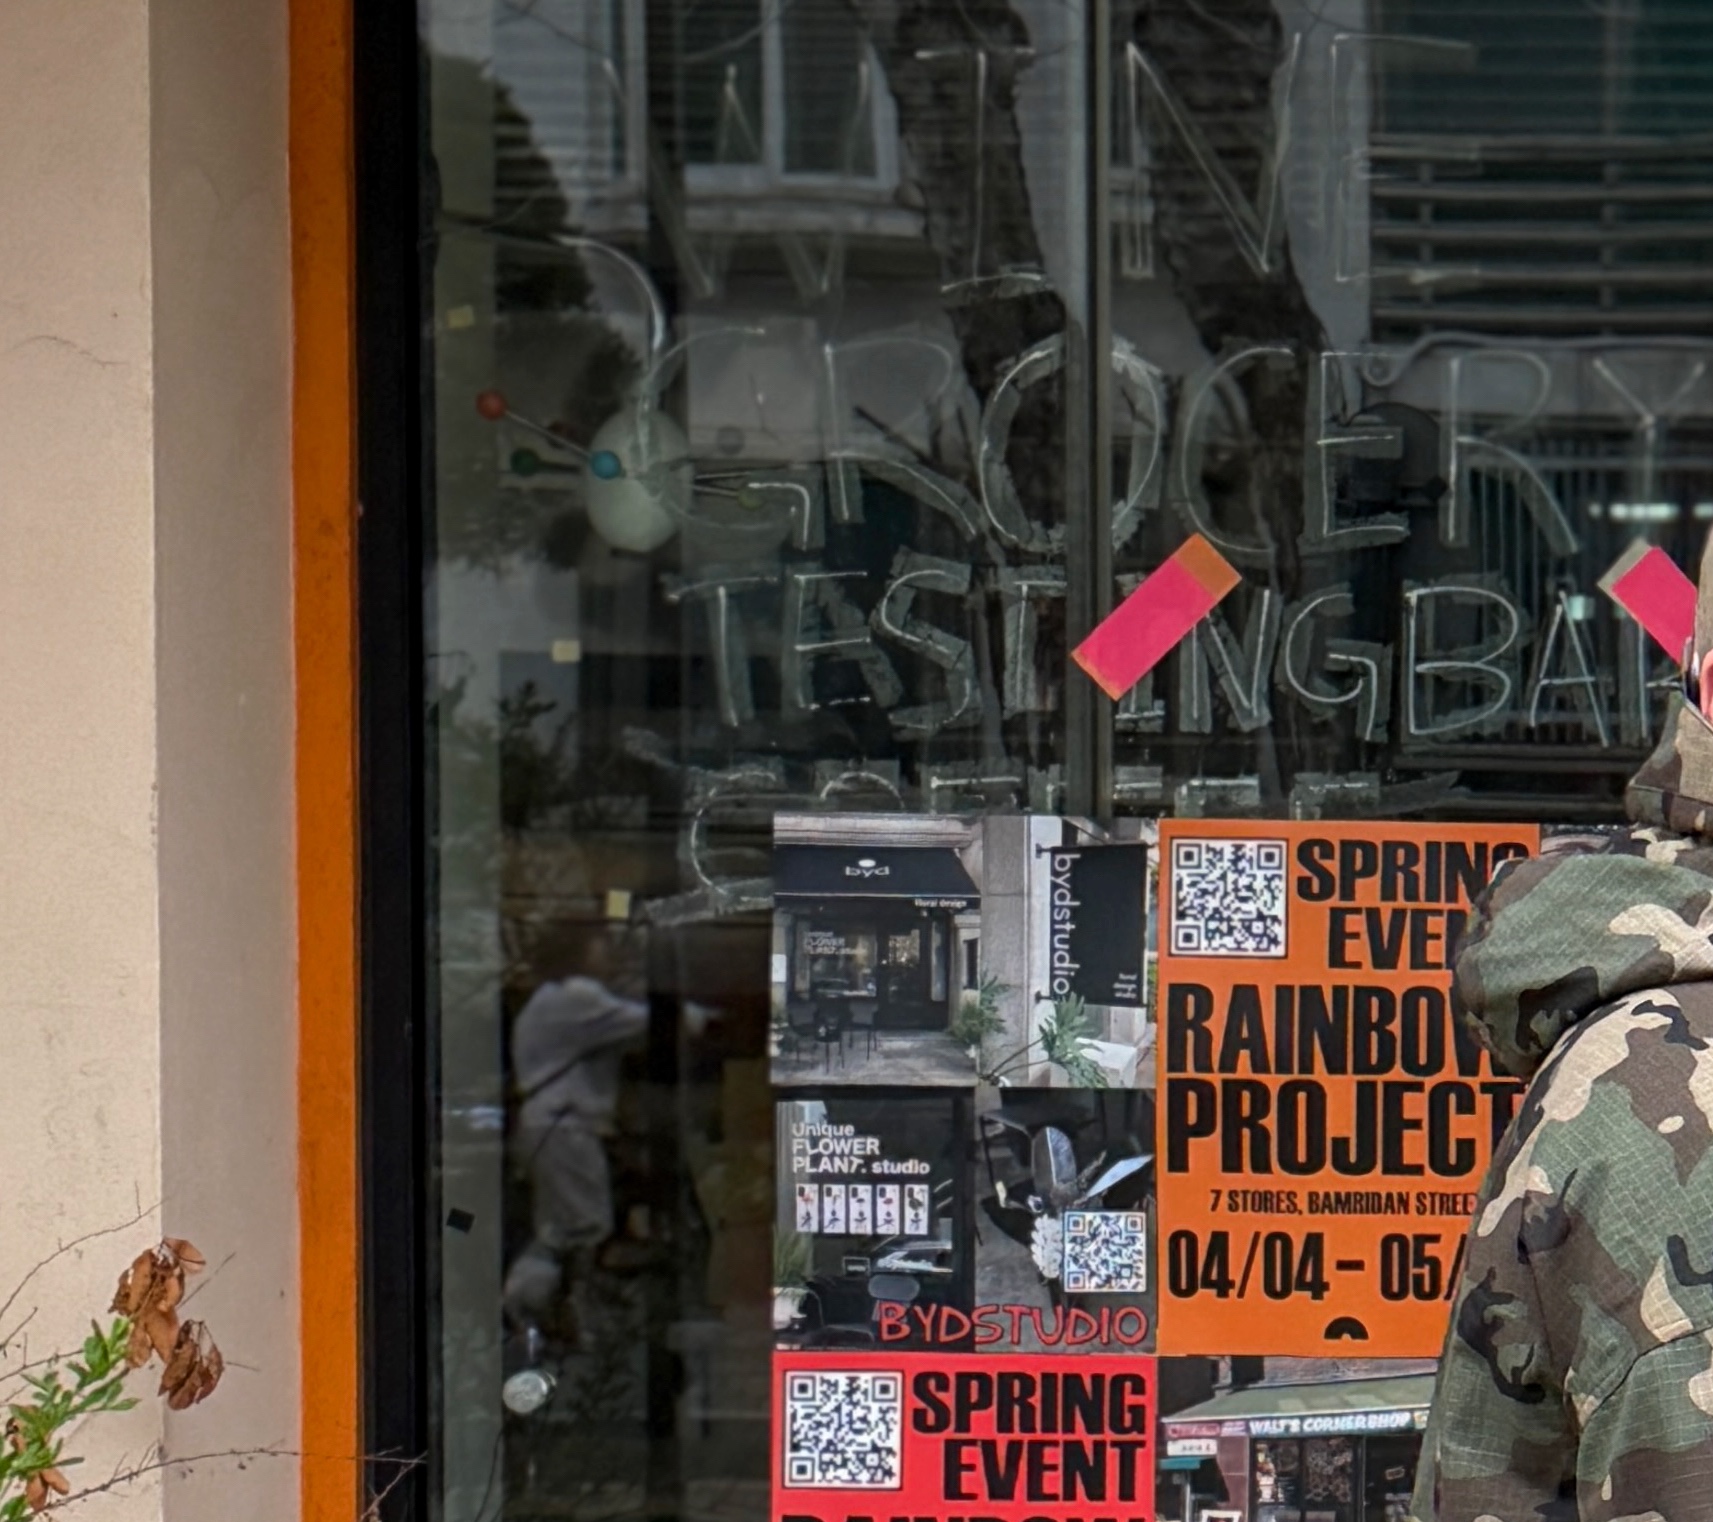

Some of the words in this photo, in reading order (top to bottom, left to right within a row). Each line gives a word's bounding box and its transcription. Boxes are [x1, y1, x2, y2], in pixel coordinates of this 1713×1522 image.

[600, 30, 1478, 302] WINE
[644, 322, 1708, 557] GROCERY
[845, 865, 890, 879] byd
[1053, 853, 1081, 995] bydstudio
[1329, 907, 1466, 970] EVE
[792, 1121, 855, 1138] Unique
[792, 1137, 879, 1155] FLOWER
[871, 1159, 930, 1174] studio
[1211, 1190, 1221, 1213] 7
[1228, 1190, 1302, 1215] STORES,
[1308, 1192, 1409, 1214] BAMRIDAN
[1416, 1192, 1476, 1215] STREE
[1169, 1230, 1328, 1300] 04/04
[1381, 1234, 1468, 1300] 05/
[879, 1301, 1148, 1346] BYDSTUDIO
[913, 1372, 1144, 1434] SPRING
[944, 1439, 1144, 1501] EVENT
